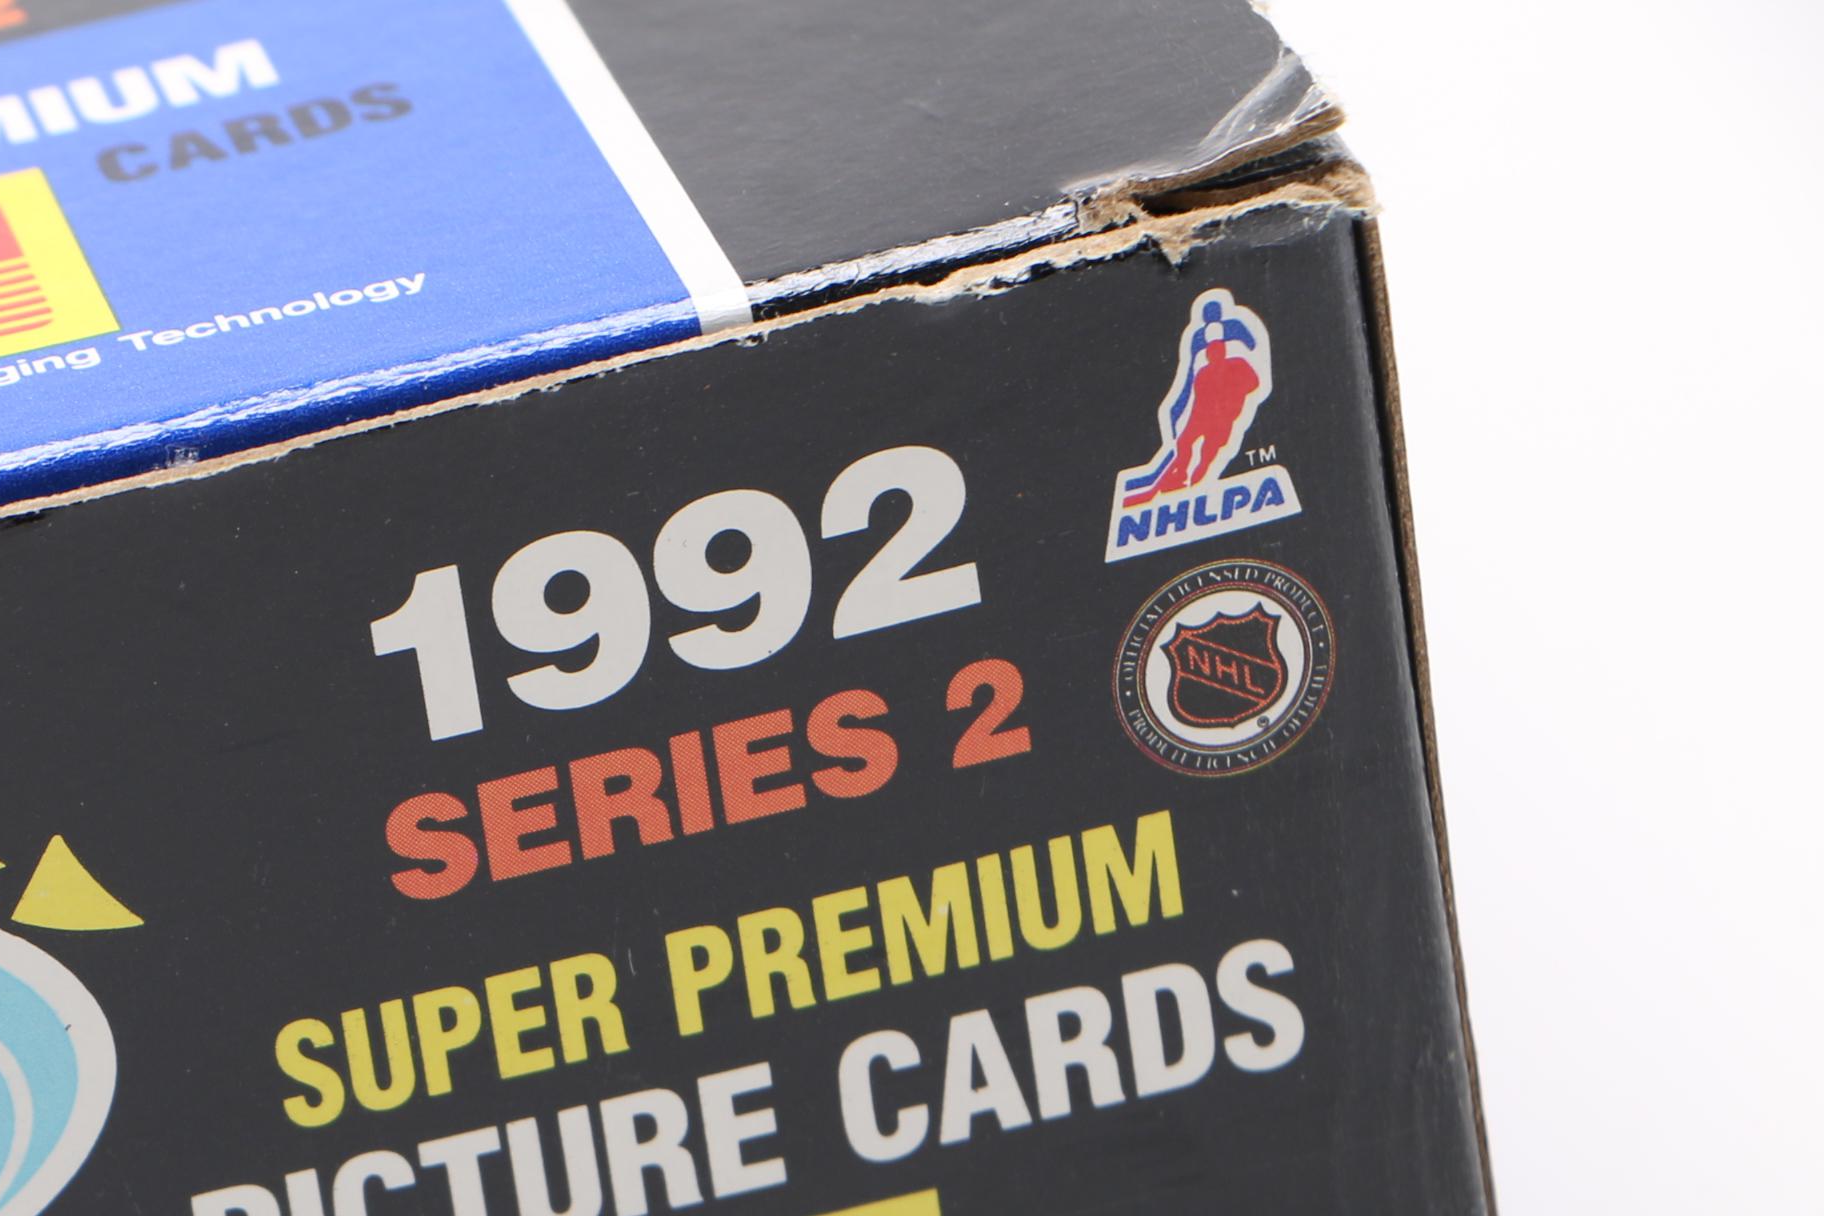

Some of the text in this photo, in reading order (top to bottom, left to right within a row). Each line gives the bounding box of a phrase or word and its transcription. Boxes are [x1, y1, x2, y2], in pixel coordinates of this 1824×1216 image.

[95, 81, 415, 185] CARDS
[118, 272, 428, 353] Technology
[1245, 444, 1277, 467] TM
[1116, 477, 1286, 548] NHLPA
[370, 445, 982, 741] 1992
[1187, 645, 1266, 695] NHL
[385, 658, 1031, 899] SERIES 2
[275, 810, 1185, 1128] SUPER PREMIUM
[837, 938, 1305, 1162] CARDS
